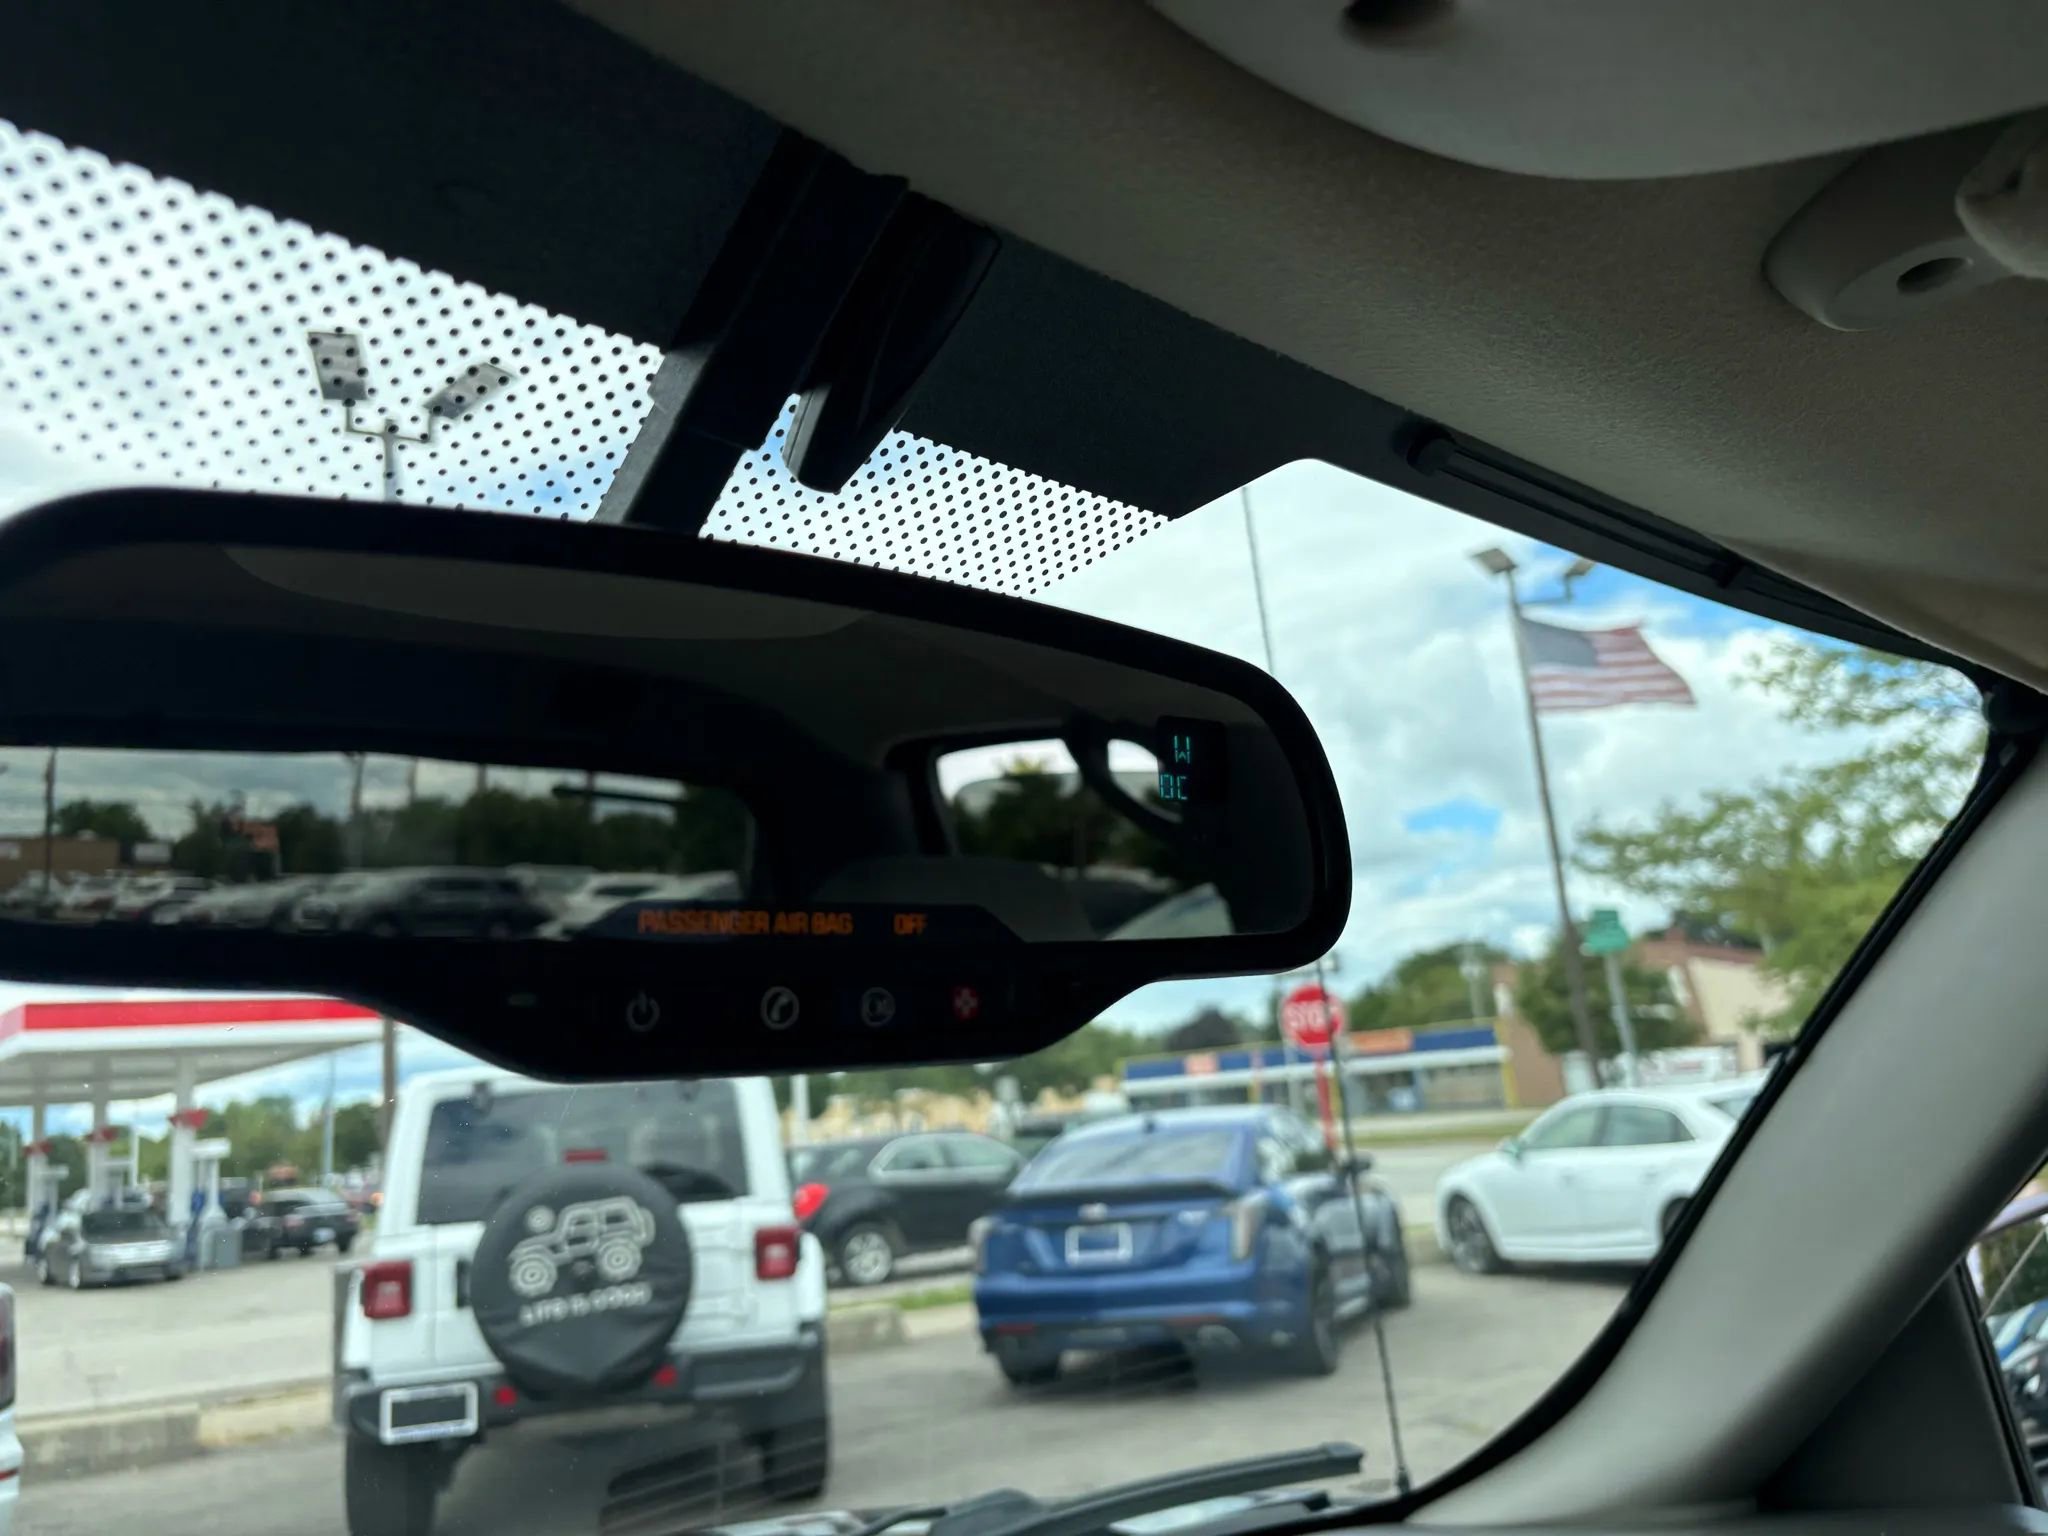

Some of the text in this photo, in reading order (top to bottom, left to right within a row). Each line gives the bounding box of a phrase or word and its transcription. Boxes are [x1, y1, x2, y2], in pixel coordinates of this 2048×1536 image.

[1174, 735, 1190, 764] W
[638, 909, 927, 935] PASSENGER AIR BAG OFF
